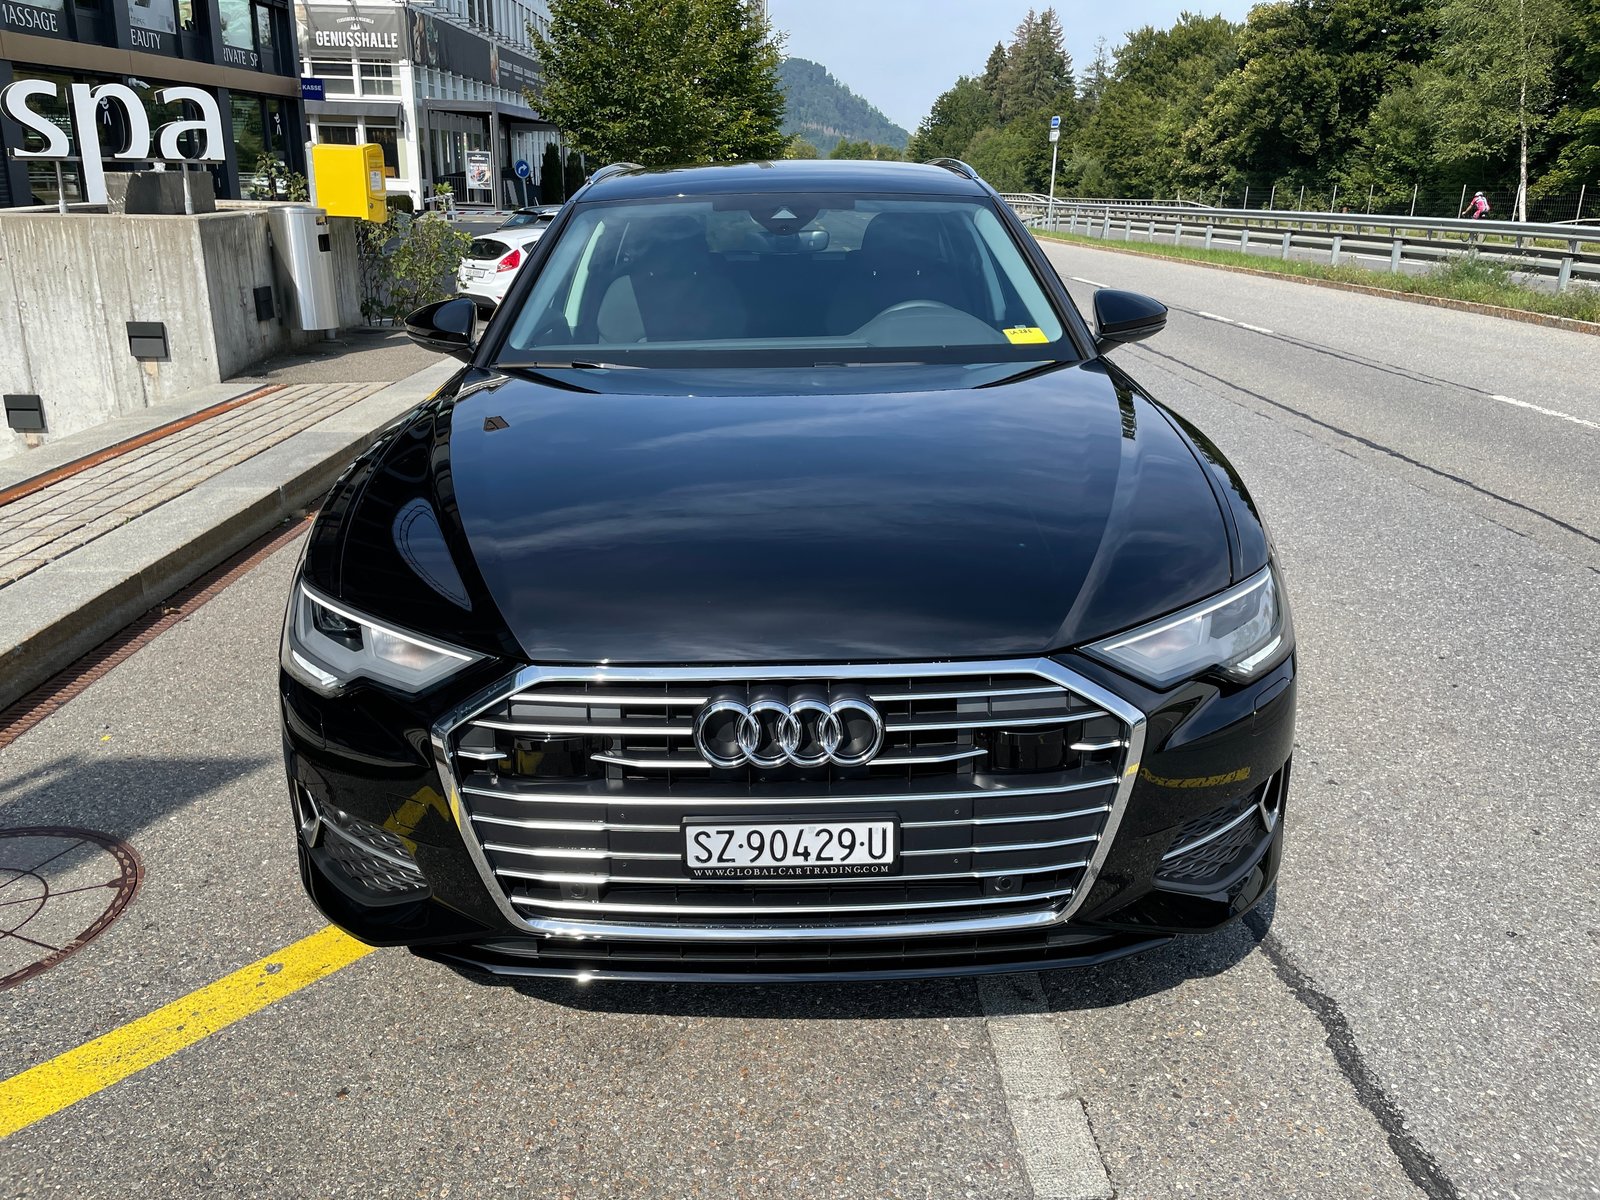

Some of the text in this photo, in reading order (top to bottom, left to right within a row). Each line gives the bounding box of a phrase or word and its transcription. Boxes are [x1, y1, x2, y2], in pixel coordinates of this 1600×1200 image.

[130, 28, 161, 50] EAUTY
[315, 30, 399, 48] GENUSSHALLE
[249, 52, 259, 67] SP
[0, 79, 226, 204] spa
